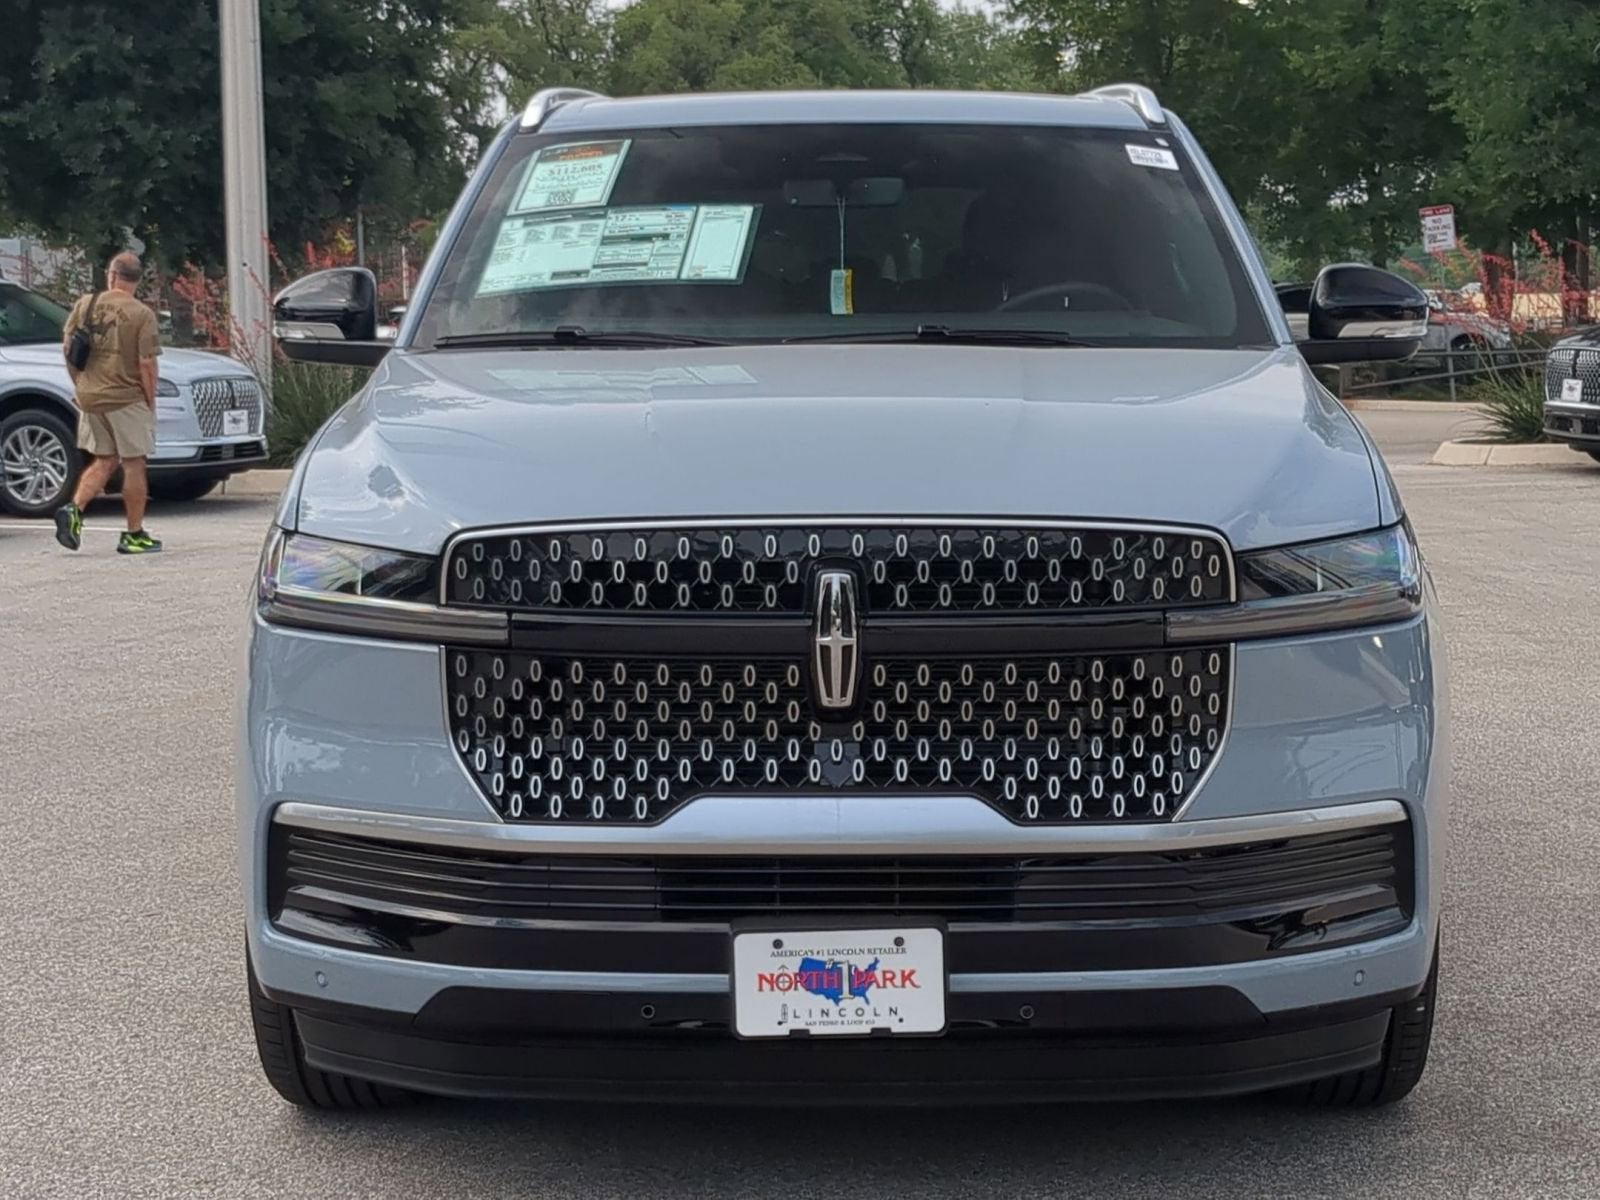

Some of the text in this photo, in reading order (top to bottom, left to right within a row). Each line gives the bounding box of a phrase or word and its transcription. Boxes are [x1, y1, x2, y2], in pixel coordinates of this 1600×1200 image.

[770, 949, 815, 958] AMERICA'S
[827, 947, 865, 956] LINCOLN
[867, 946, 907, 955] RETAILER
[758, 968, 921, 992] NORTH PARK
[793, 1006, 898, 1019] LINCOLN
